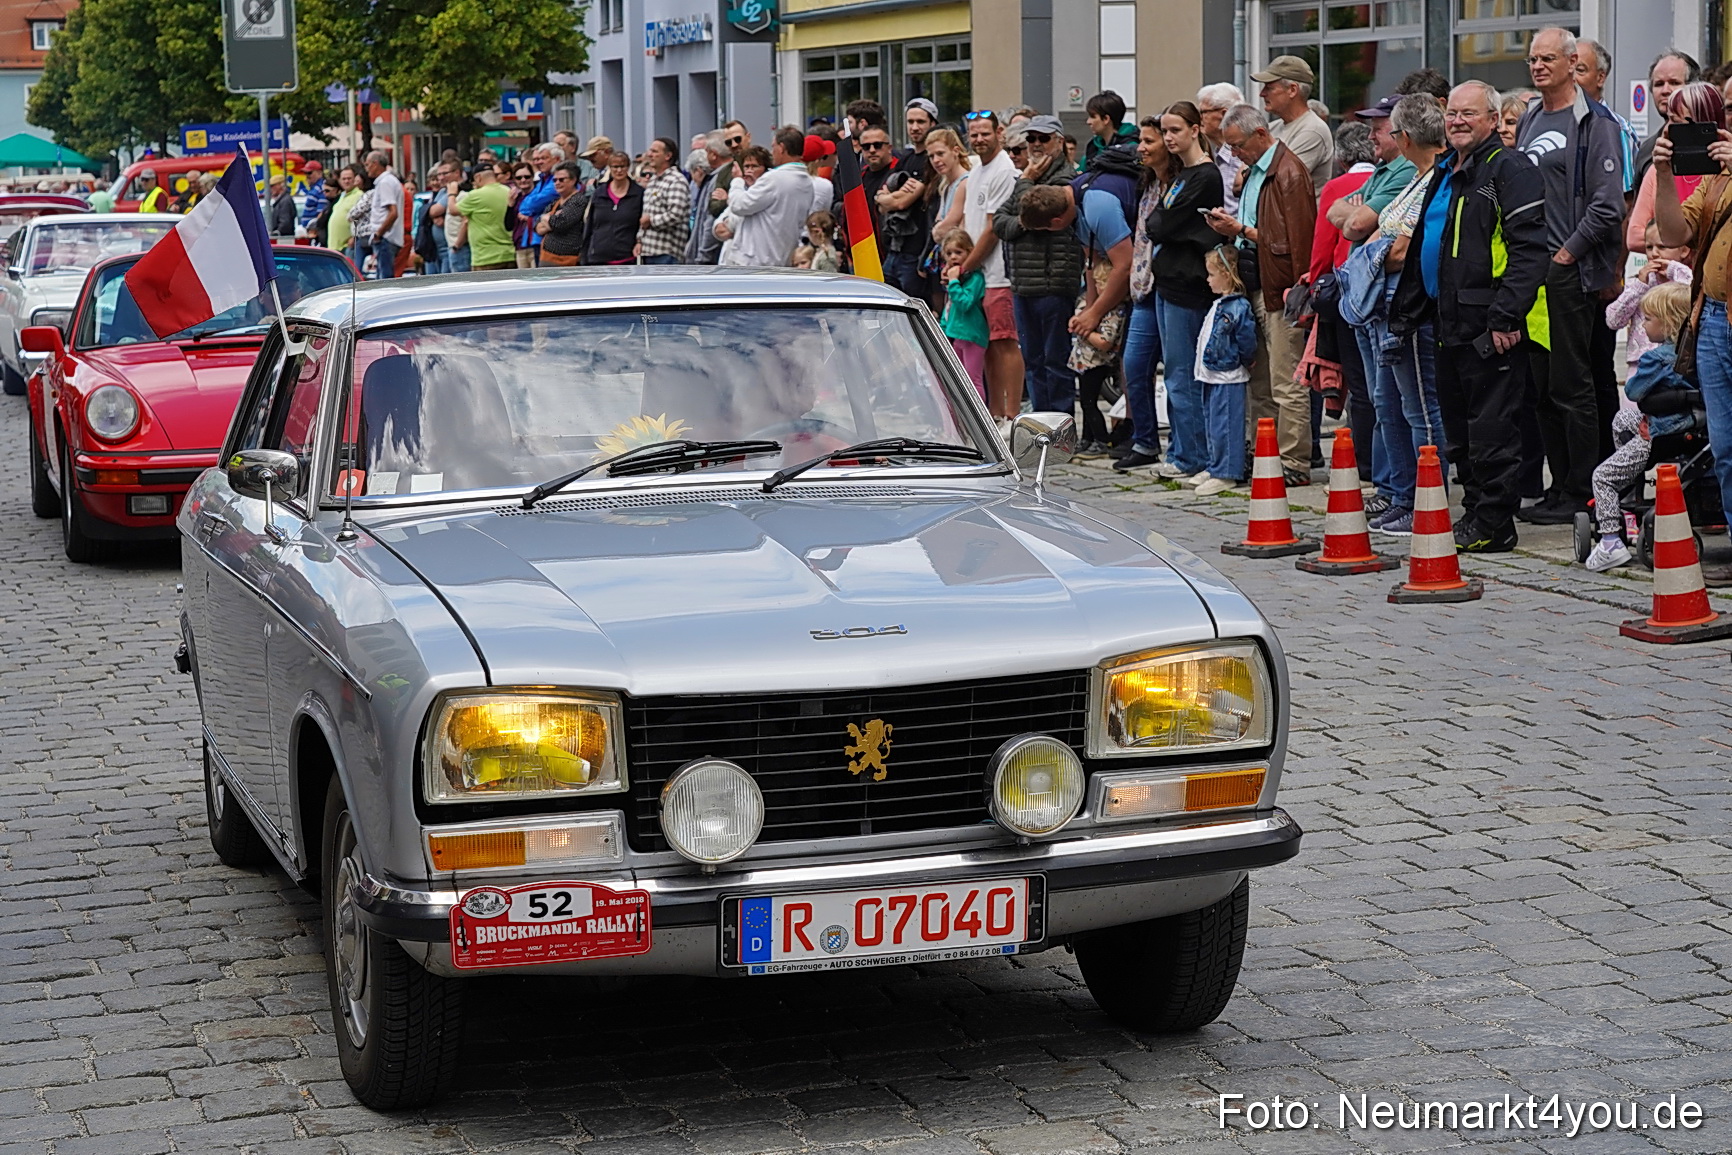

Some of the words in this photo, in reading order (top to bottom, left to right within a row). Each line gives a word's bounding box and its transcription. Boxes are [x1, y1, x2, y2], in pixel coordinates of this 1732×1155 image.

[247, 27, 272, 35] ZONE
[810, 624, 908, 640] 304
[528, 891, 573, 918] 52
[595, 900, 607, 908] 19.
[609, 898, 624, 906] Mai
[625, 896, 645, 905] 2018
[476, 922, 582, 944] BRUCKMANDL
[586, 911, 645, 933] RALLYE
[783, 902, 815, 952] R
[854, 887, 1015, 947] 07040
[751, 937, 763, 951] D
[767, 963, 823, 973] EG-Fahrzeuge
[829, 960, 853, 969] AUTO
[855, 953, 906, 967] SCHWEIGER
[970, 949, 979, 957] 64
